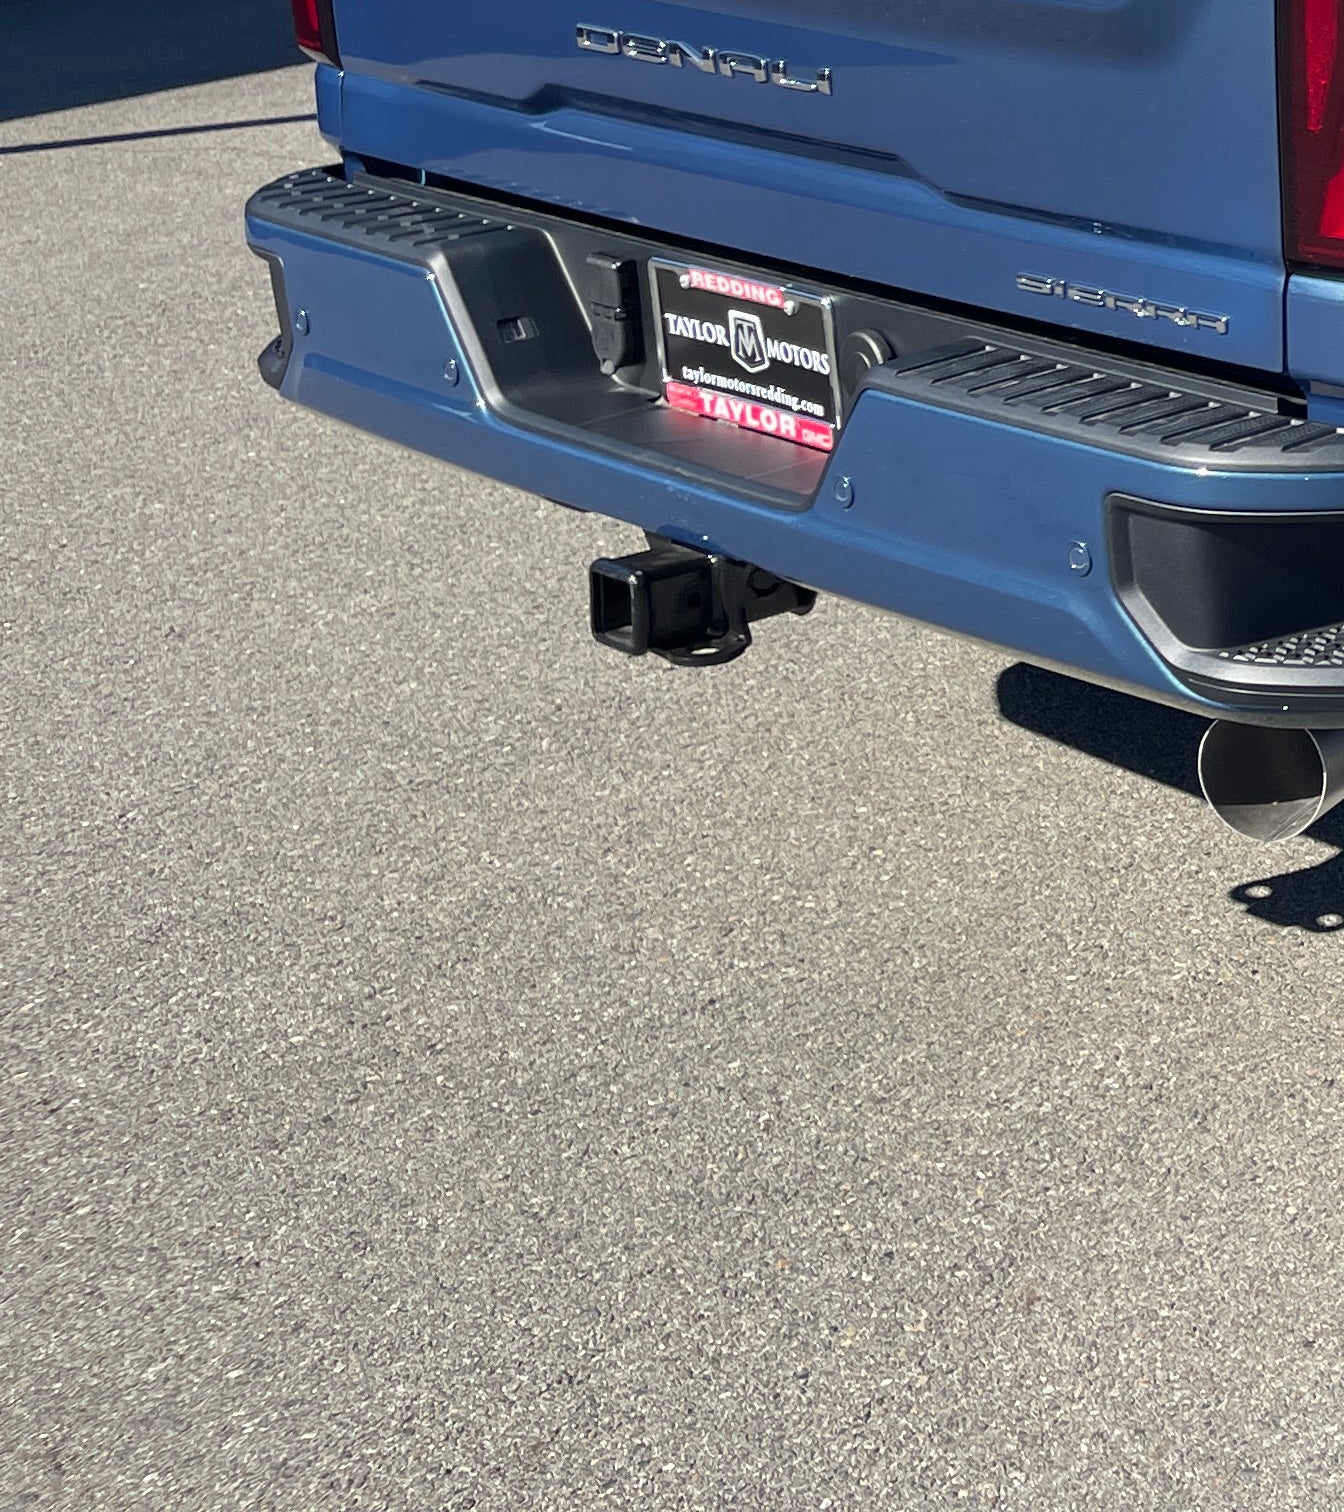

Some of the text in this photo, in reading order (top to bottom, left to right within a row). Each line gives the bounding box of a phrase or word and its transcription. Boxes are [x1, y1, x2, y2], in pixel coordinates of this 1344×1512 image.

[576, 22, 833, 96] DENALI
[689, 270, 781, 306] REDDING
[1016, 271, 1231, 336] SIERRA
[664, 312, 730, 347] TAYLOR
[766, 338, 831, 375] MOTORS
[682, 365, 825, 417] taylormotorsredding.com
[700, 391, 797, 437] TAYLOR
